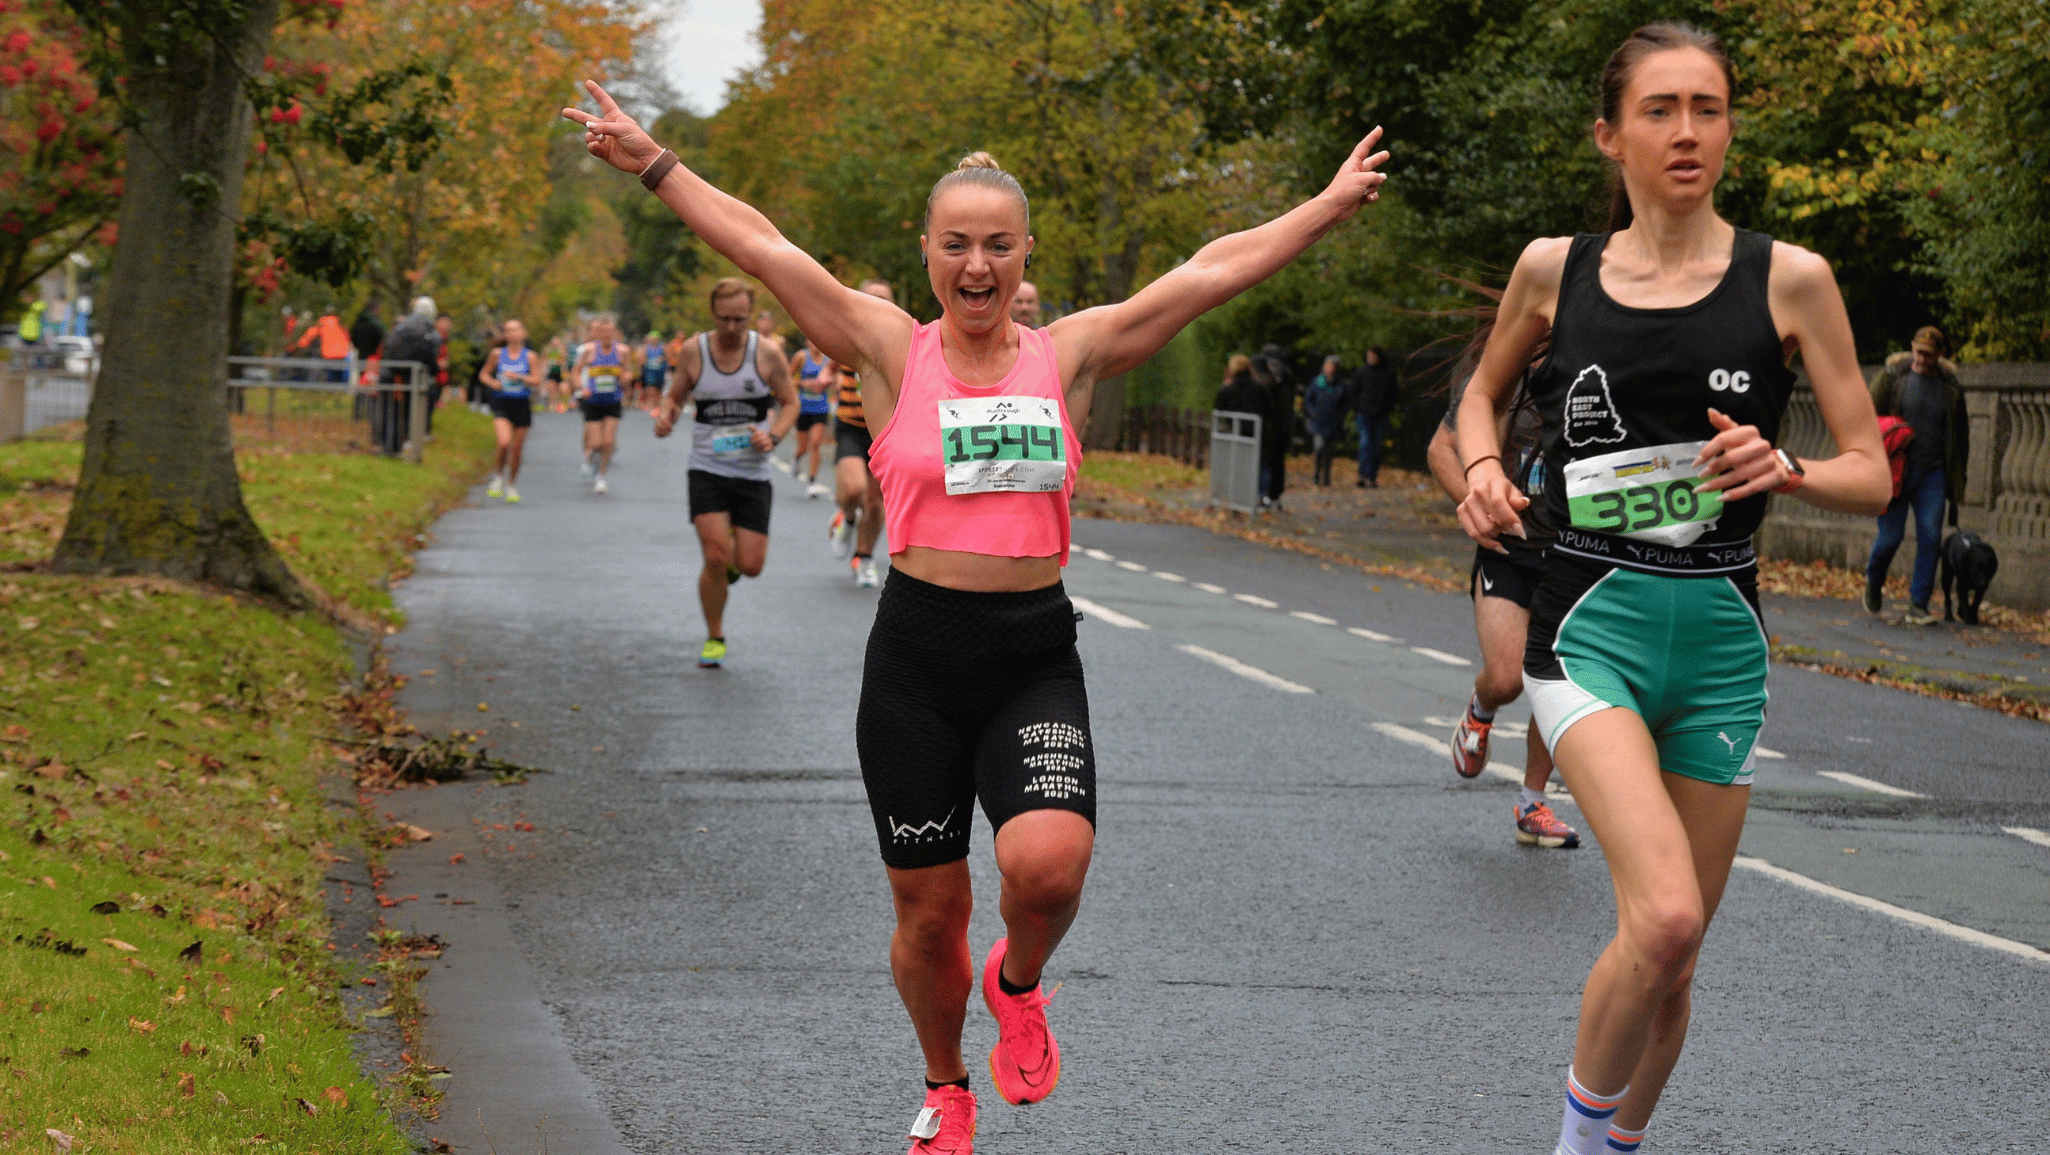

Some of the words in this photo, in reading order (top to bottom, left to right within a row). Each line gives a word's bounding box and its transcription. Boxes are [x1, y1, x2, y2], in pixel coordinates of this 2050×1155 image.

[1708, 368, 1750, 393] OC
[1572, 403, 1593, 411] EAST
[1572, 410, 1609, 419] PROJECT
[948, 425, 1058, 462] 1544
[1039, 483, 1060, 491] 1544
[1591, 480, 1699, 533] 330
[1566, 533, 1610, 553] PUMA
[1645, 548, 1694, 566] PUMA
[1725, 546, 1754, 563] PUM
[1023, 728, 1084, 742] GATESHEAD
[1023, 734, 1085, 749] MARATHON
[1044, 741, 1069, 749] 2024
[1023, 753, 1084, 766] MANCHESTER
[1029, 759, 1080, 769] MARATHON
[1032, 775, 1079, 786] LONDON
[1024, 782, 1086, 796] MARATHON
